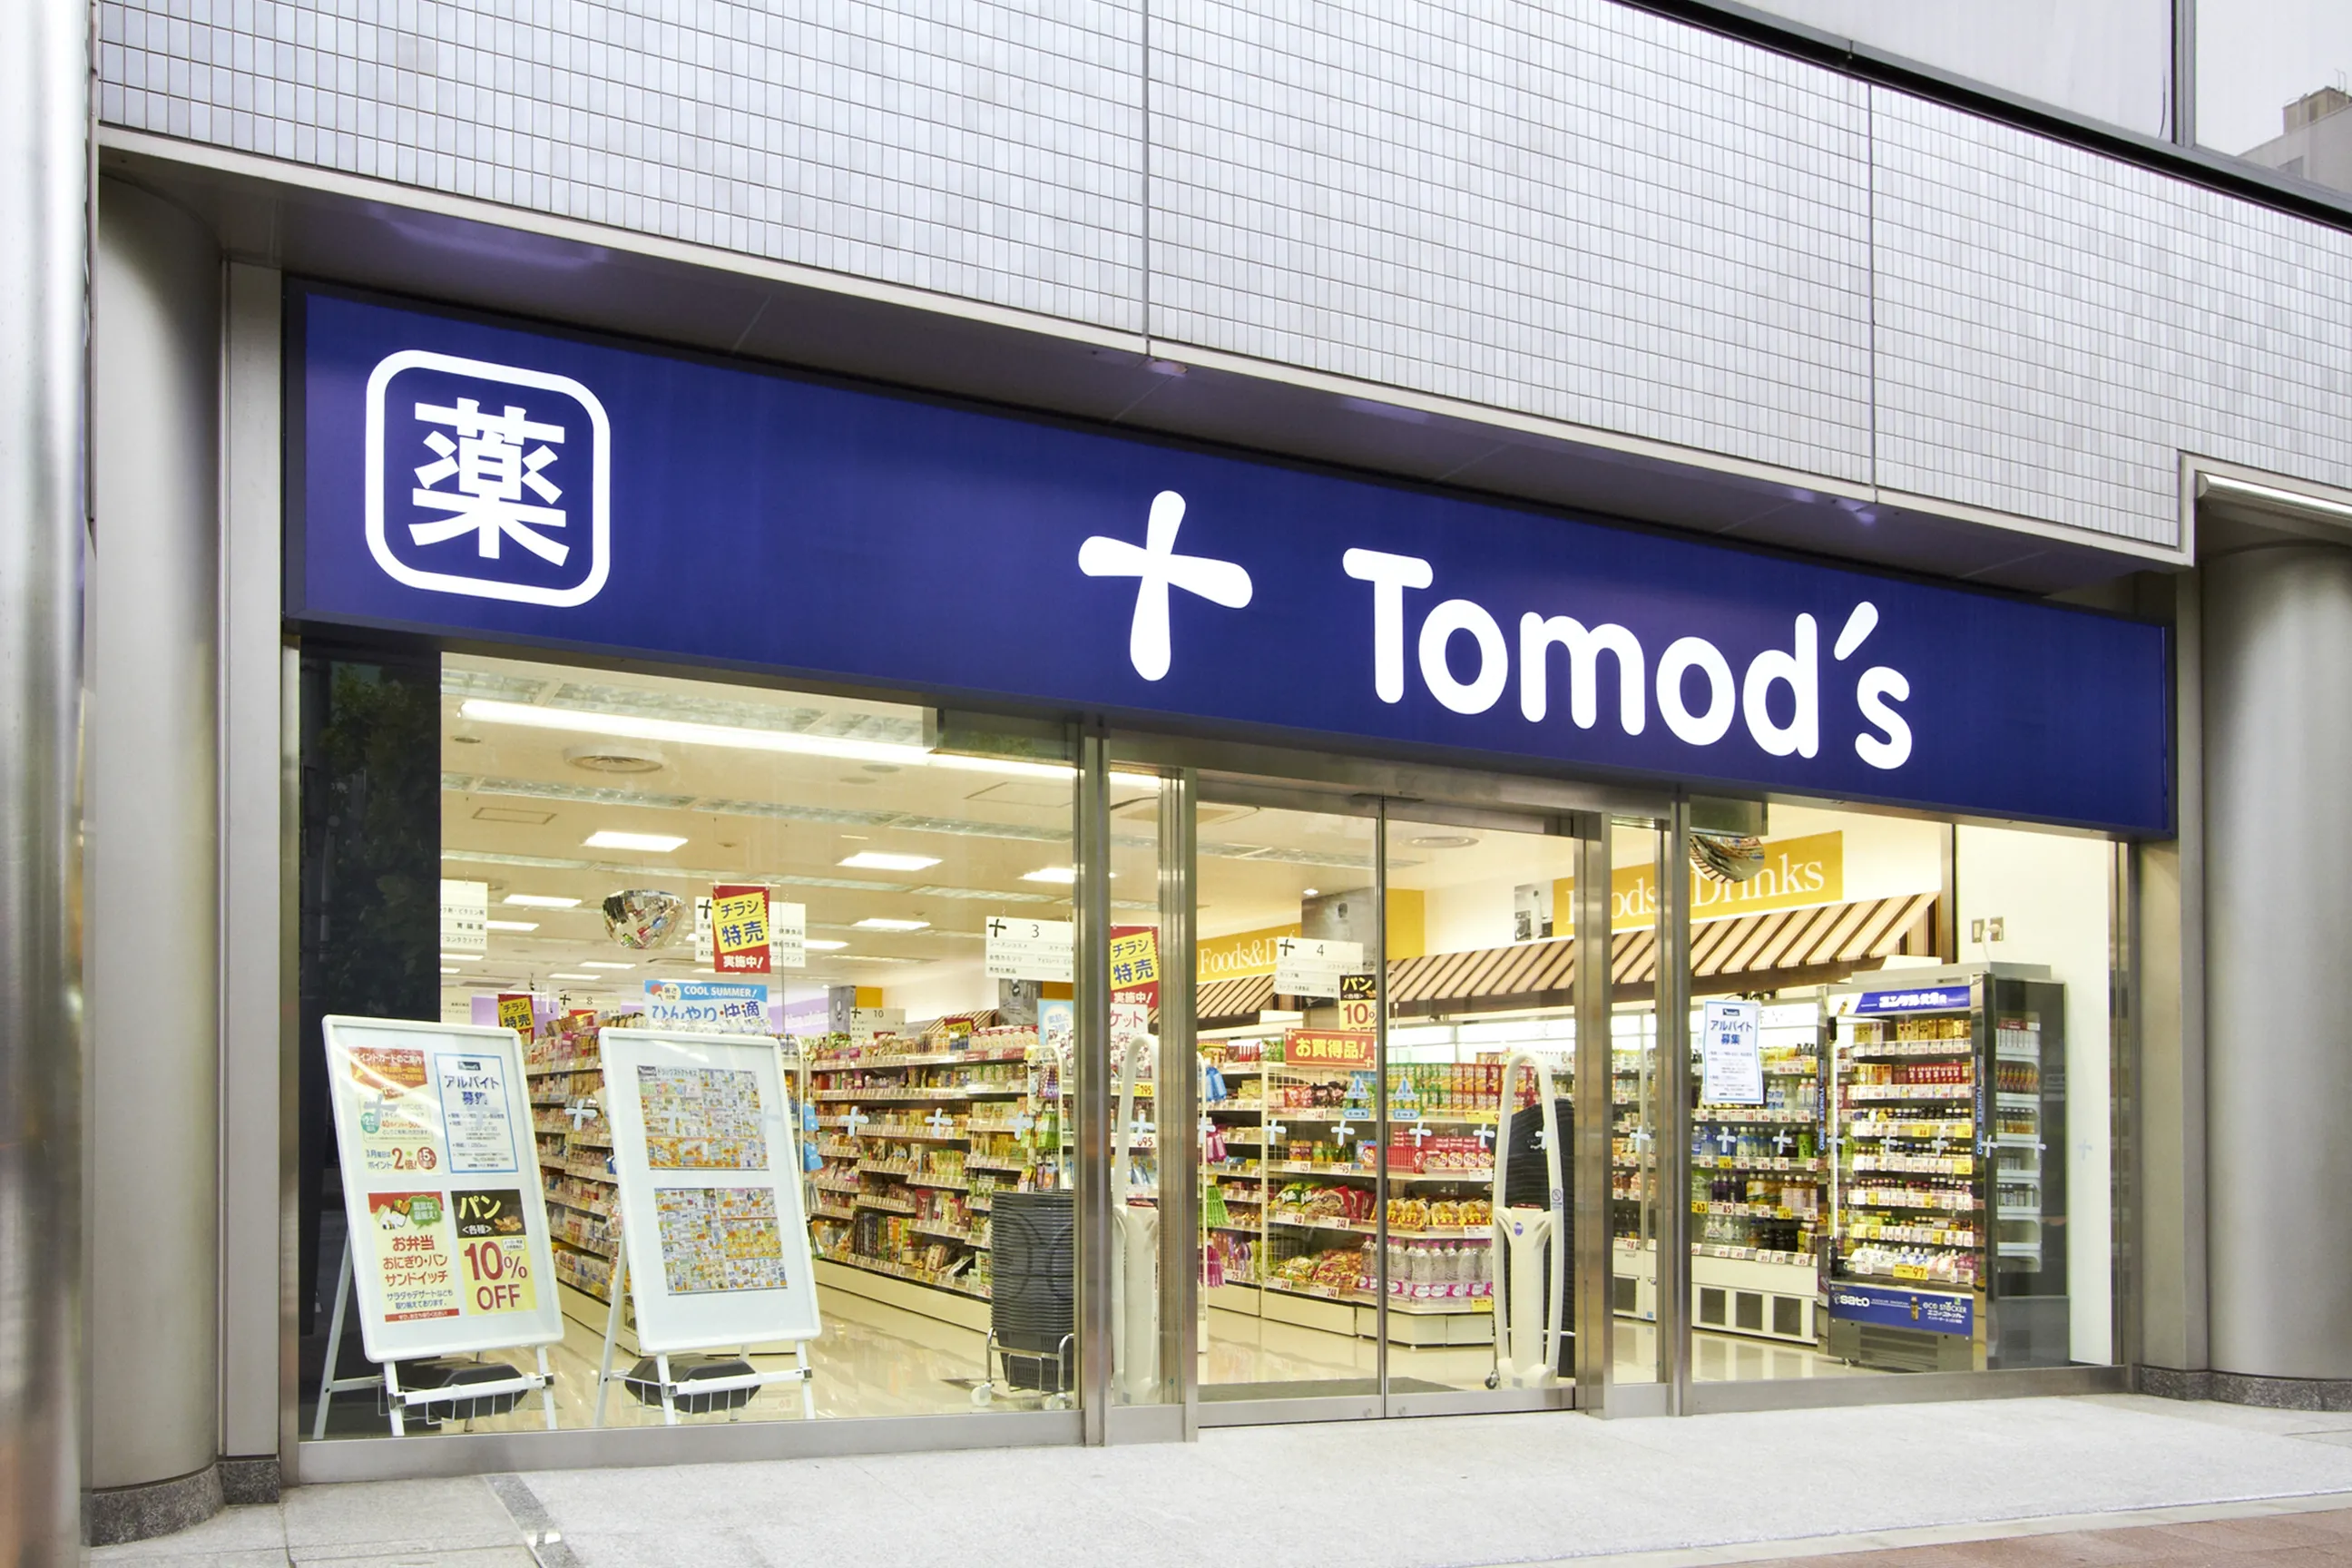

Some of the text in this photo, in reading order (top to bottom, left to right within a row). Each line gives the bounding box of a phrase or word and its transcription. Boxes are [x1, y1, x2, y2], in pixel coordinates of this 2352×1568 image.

[408, 397, 570, 567] 薬
[1342, 547, 1913, 769] Tomod's
[720, 900, 759, 918] チラシ
[721, 920, 764, 947] 特売
[1031, 924, 1040, 938] 3
[1112, 939, 1149, 958] チラシ
[1316, 944, 1325, 956] 4
[723, 955, 763, 970] 実施中!
[1112, 958, 1154, 985] 特売
[684, 985, 757, 999] COOL SUMMER!
[1343, 976, 1373, 992] パン
[1113, 992, 1153, 1004] 実施中!
[503, 1002, 527, 1014] チラシ
[874, 1010, 885, 1018] 10
[504, 1013, 532, 1029] 特売
[1710, 1020, 1753, 1032] アルバイト
[1295, 1037, 1367, 1060] お買得品!
[445, 1075, 499, 1089] アルバイト
[458, 1195, 502, 1220] パン
[391, 1234, 436, 1252] お弁当
[383, 1253, 448, 1270] おにぎり・パン
[464, 1240, 528, 1281] 10%
[385, 1270, 448, 1287] サンドイッチ
[1912, 1267, 1925, 1275] 97
[476, 1283, 521, 1311] OFF
